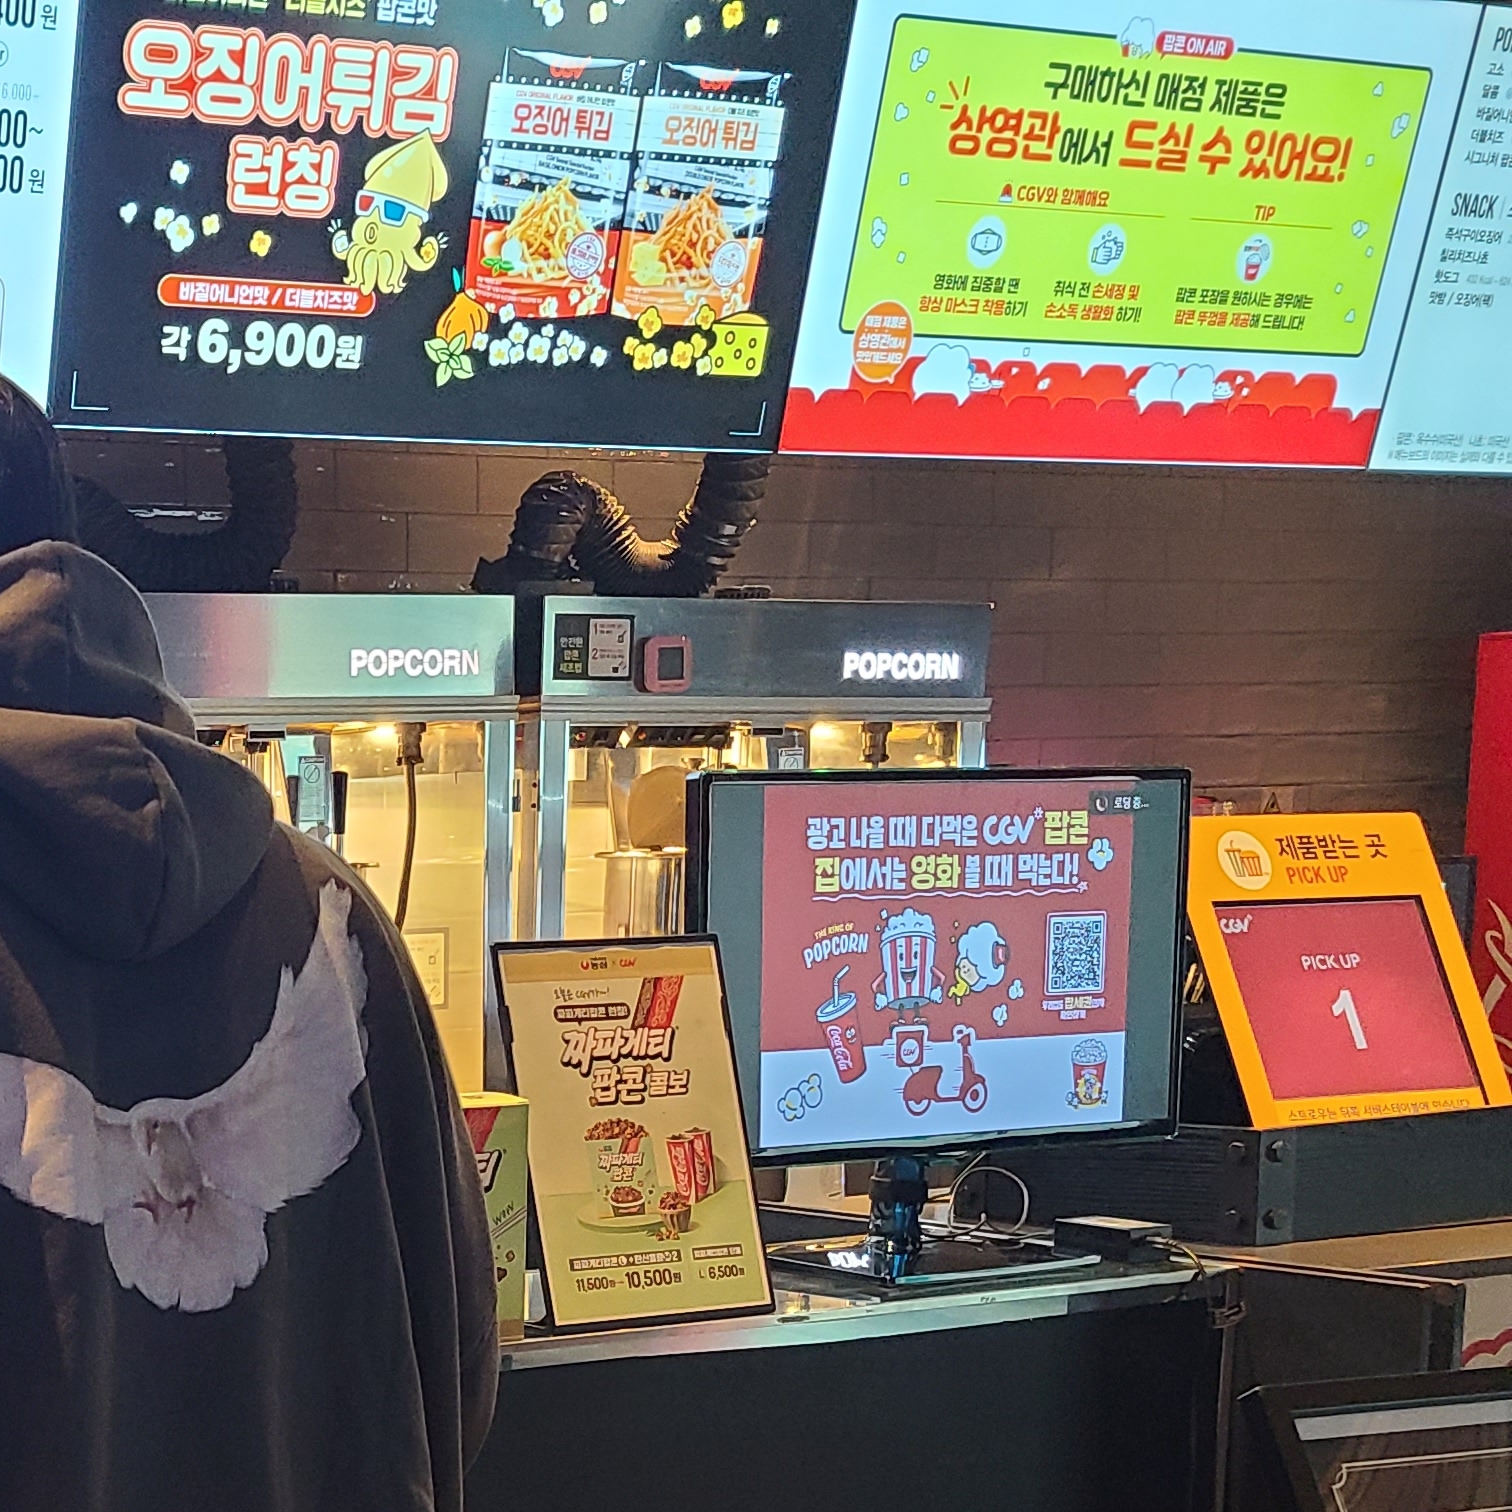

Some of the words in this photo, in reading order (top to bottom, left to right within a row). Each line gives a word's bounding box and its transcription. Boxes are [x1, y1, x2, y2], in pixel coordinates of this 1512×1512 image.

[1162, 34, 1187, 53] 팝콘
[1188, 36, 1204, 54] ON
[1204, 38, 1227, 57] AIR
[118, 19, 459, 143] 오징어튀김
[1486, 62, 1505, 77] 고소
[1044, 61, 1152, 108] 구매하신
[1152, 71, 1209, 114] 매점
[1208, 77, 1288, 120] 제품은
[510, 103, 571, 139] 오징어
[573, 107, 614, 143] 튀김
[661, 114, 720, 150] 오징어
[720, 118, 760, 152] 튀김
[947, 103, 1115, 168] 상영관에서
[1118, 119, 1195, 174] 드실
[1197, 125, 1233, 176] 수
[1238, 128, 1354, 184] 있어요!
[1470, 128, 1505, 145] 더블치즈
[1464, 150, 1499, 168] 시그니처
[227, 134, 340, 219] 런칭
[1016, 185, 1058, 205] CGV와
[1060, 188, 1110, 208] 함께해요
[1450, 192, 1499, 220] SNACK
[1254, 204, 1277, 222] TIP
[1444, 226, 1504, 245] 즉석구이오징어
[933, 273, 968, 292] 영화에
[970, 276, 1007, 295] 집중할
[1434, 269, 1460, 284] 핫도그
[178, 280, 270, 307] 바질어니언맛
[284, 286, 360, 313] 더블치즈맛
[1053, 280, 1076, 298] 취식
[1078, 282, 1091, 298] 전
[1092, 282, 1127, 301] 손세정
[1128, 284, 1141, 301] 및
[1175, 287, 1197, 304] 팝콘
[1198, 289, 1230, 305] 포장을
[1231, 291, 1273, 309] 원하시는
[1274, 293, 1314, 310] 경우에는
[919, 296, 944, 313] 항상
[945, 297, 980, 315] 마스크
[982, 299, 1029, 318] 착용하기
[1044, 302, 1078, 320] 손소독
[1080, 303, 1115, 322] 생활화
[1116, 306, 1142, 323] 하기!
[1174, 309, 1196, 326] 팝콘
[1197, 312, 1229, 328] 뚜껑을
[1229, 313, 1261, 330] 제공해
[1261, 316, 1305, 331] 드립니다!
[160, 324, 192, 361] 각
[196, 316, 364, 375] 6,900원
[349, 648, 480, 679] POPCORN
[841, 651, 961, 681] POPCORN
[1113, 796, 1132, 810] 로딩
[805, 816, 846, 850] 광고
[849, 815, 886, 849] 나올
[890, 814, 917, 848] 때
[920, 813, 979, 846] 다먹은
[982, 813, 1035, 846] CGV
[1043, 809, 1089, 845] 팝콘
[1274, 834, 1360, 861] 제품받는
[1362, 833, 1389, 859] 곳
[813, 856, 908, 893] 집에서는
[910, 853, 961, 889] 영화
[963, 853, 981, 888] 볼
[984, 853, 1014, 887] 때
[1016, 852, 1080, 886] 먹는다!
[1286, 865, 1327, 885] PICK
[1327, 865, 1349, 884] UP
[1219, 914, 1253, 934] CGV
[802, 933, 870, 969] POPCORN
[1300, 954, 1338, 971] PICK
[1338, 952, 1362, 969] UP
[1330, 988, 1369, 1050] 1
[561, 1026, 677, 1076] 짜파게티
[589, 1064, 648, 1106] 팝콘
[647, 1068, 690, 1097] 콤보
